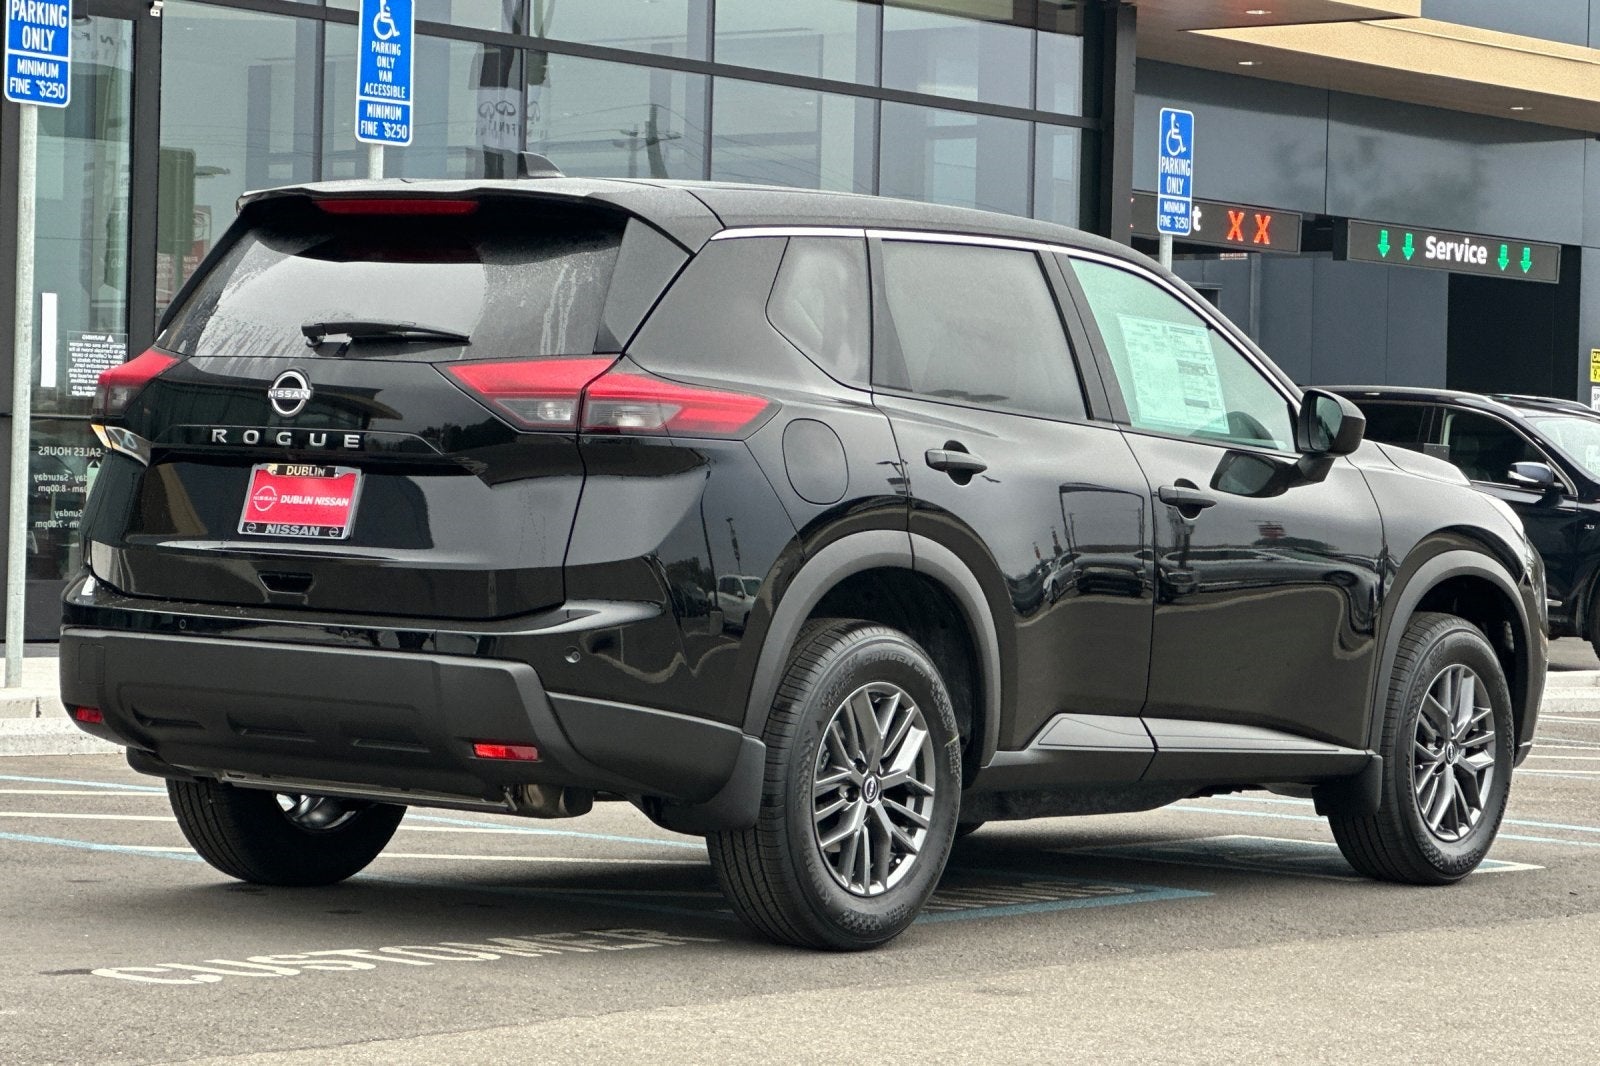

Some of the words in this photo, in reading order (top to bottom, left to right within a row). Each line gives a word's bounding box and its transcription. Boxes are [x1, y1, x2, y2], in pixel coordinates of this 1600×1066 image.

[11, 0, 67, 28] PARKING
[22, 25, 55, 52] ONLY
[371, 41, 401, 56] PARKING
[17, 58, 59, 79] MINIMUM
[376, 55, 395, 69] ONLY
[378, 70, 393, 83] VAN
[10, 76, 31, 95] FINE
[38, 80, 65, 99] $250
[364, 82, 406, 98] ACCESSIBLE
[367, 103, 402, 121] MINIMUM
[360, 120, 378, 136] FINE
[383, 122, 407, 139] $250
[1161, 156, 1191, 176] PARKING
[1166, 176, 1184, 195] ONLY
[1163, 200, 1186, 214] MINIMUM
[1160, 214, 1171, 227] FINE
[1173, 216, 1189, 229] $250
[1425, 235, 1488, 265] Service
[268, 389, 311, 400] NISSAN
[211, 428, 361, 449] ROGUE
[286, 465, 326, 477] DUBLIN
[280, 495, 313, 505] DUBLIN
[315, 496, 349, 506] NISSAN
[265, 524, 320, 536] NISSAN
[91, 927, 723, 986] CUSTOMER
